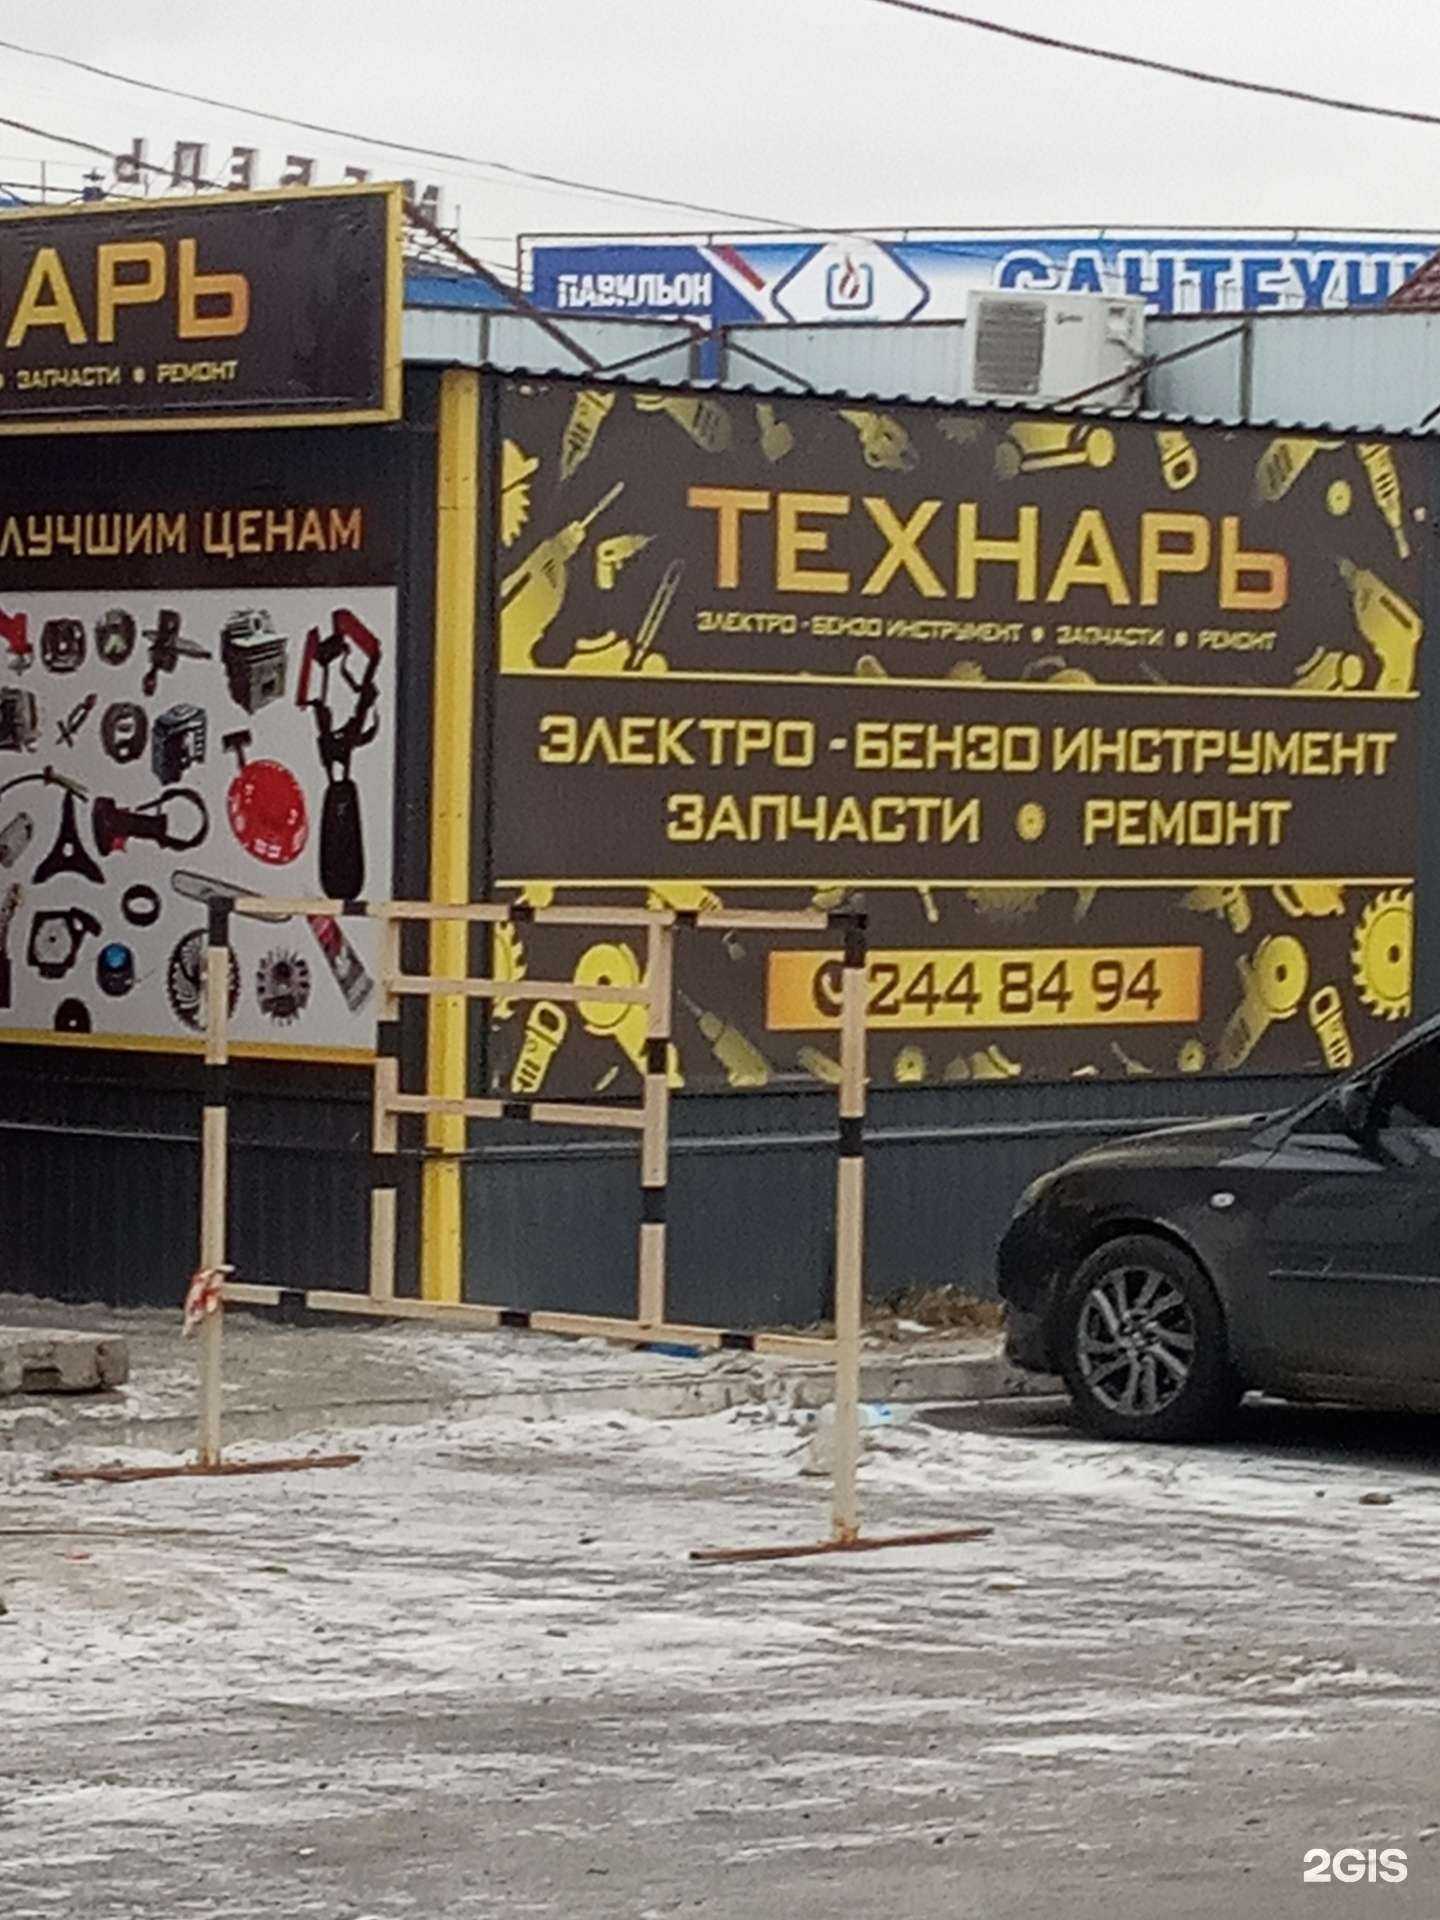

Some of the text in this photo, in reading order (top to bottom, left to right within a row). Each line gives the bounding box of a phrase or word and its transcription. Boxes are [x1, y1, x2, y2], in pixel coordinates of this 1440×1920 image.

[557, 272, 712, 309] ПАВИЛЬОН
[16, 360, 238, 390] ЗАПЧАСТИ РЕМОНТ
[0, 508, 362, 559] ЛУЧШИМ ЦЕНАМ
[687, 486, 1290, 611] ТЕХНАРЬ
[886, 619, 1023, 643] ИНСТРУМЕНТ
[1056, 625, 1164, 647] ЗАПЧАСТИ
[1199, 629, 1277, 650] РЕМОНТ
[539, 715, 816, 768] ЭЛЕКТРО
[1052, 727, 1398, 776] ИНСТРУМЕНТ
[666, 793, 1292, 846] ЗАПЧАСТИ РЕМОНТ
[866, 958, 1162, 1016] 244 84 94
